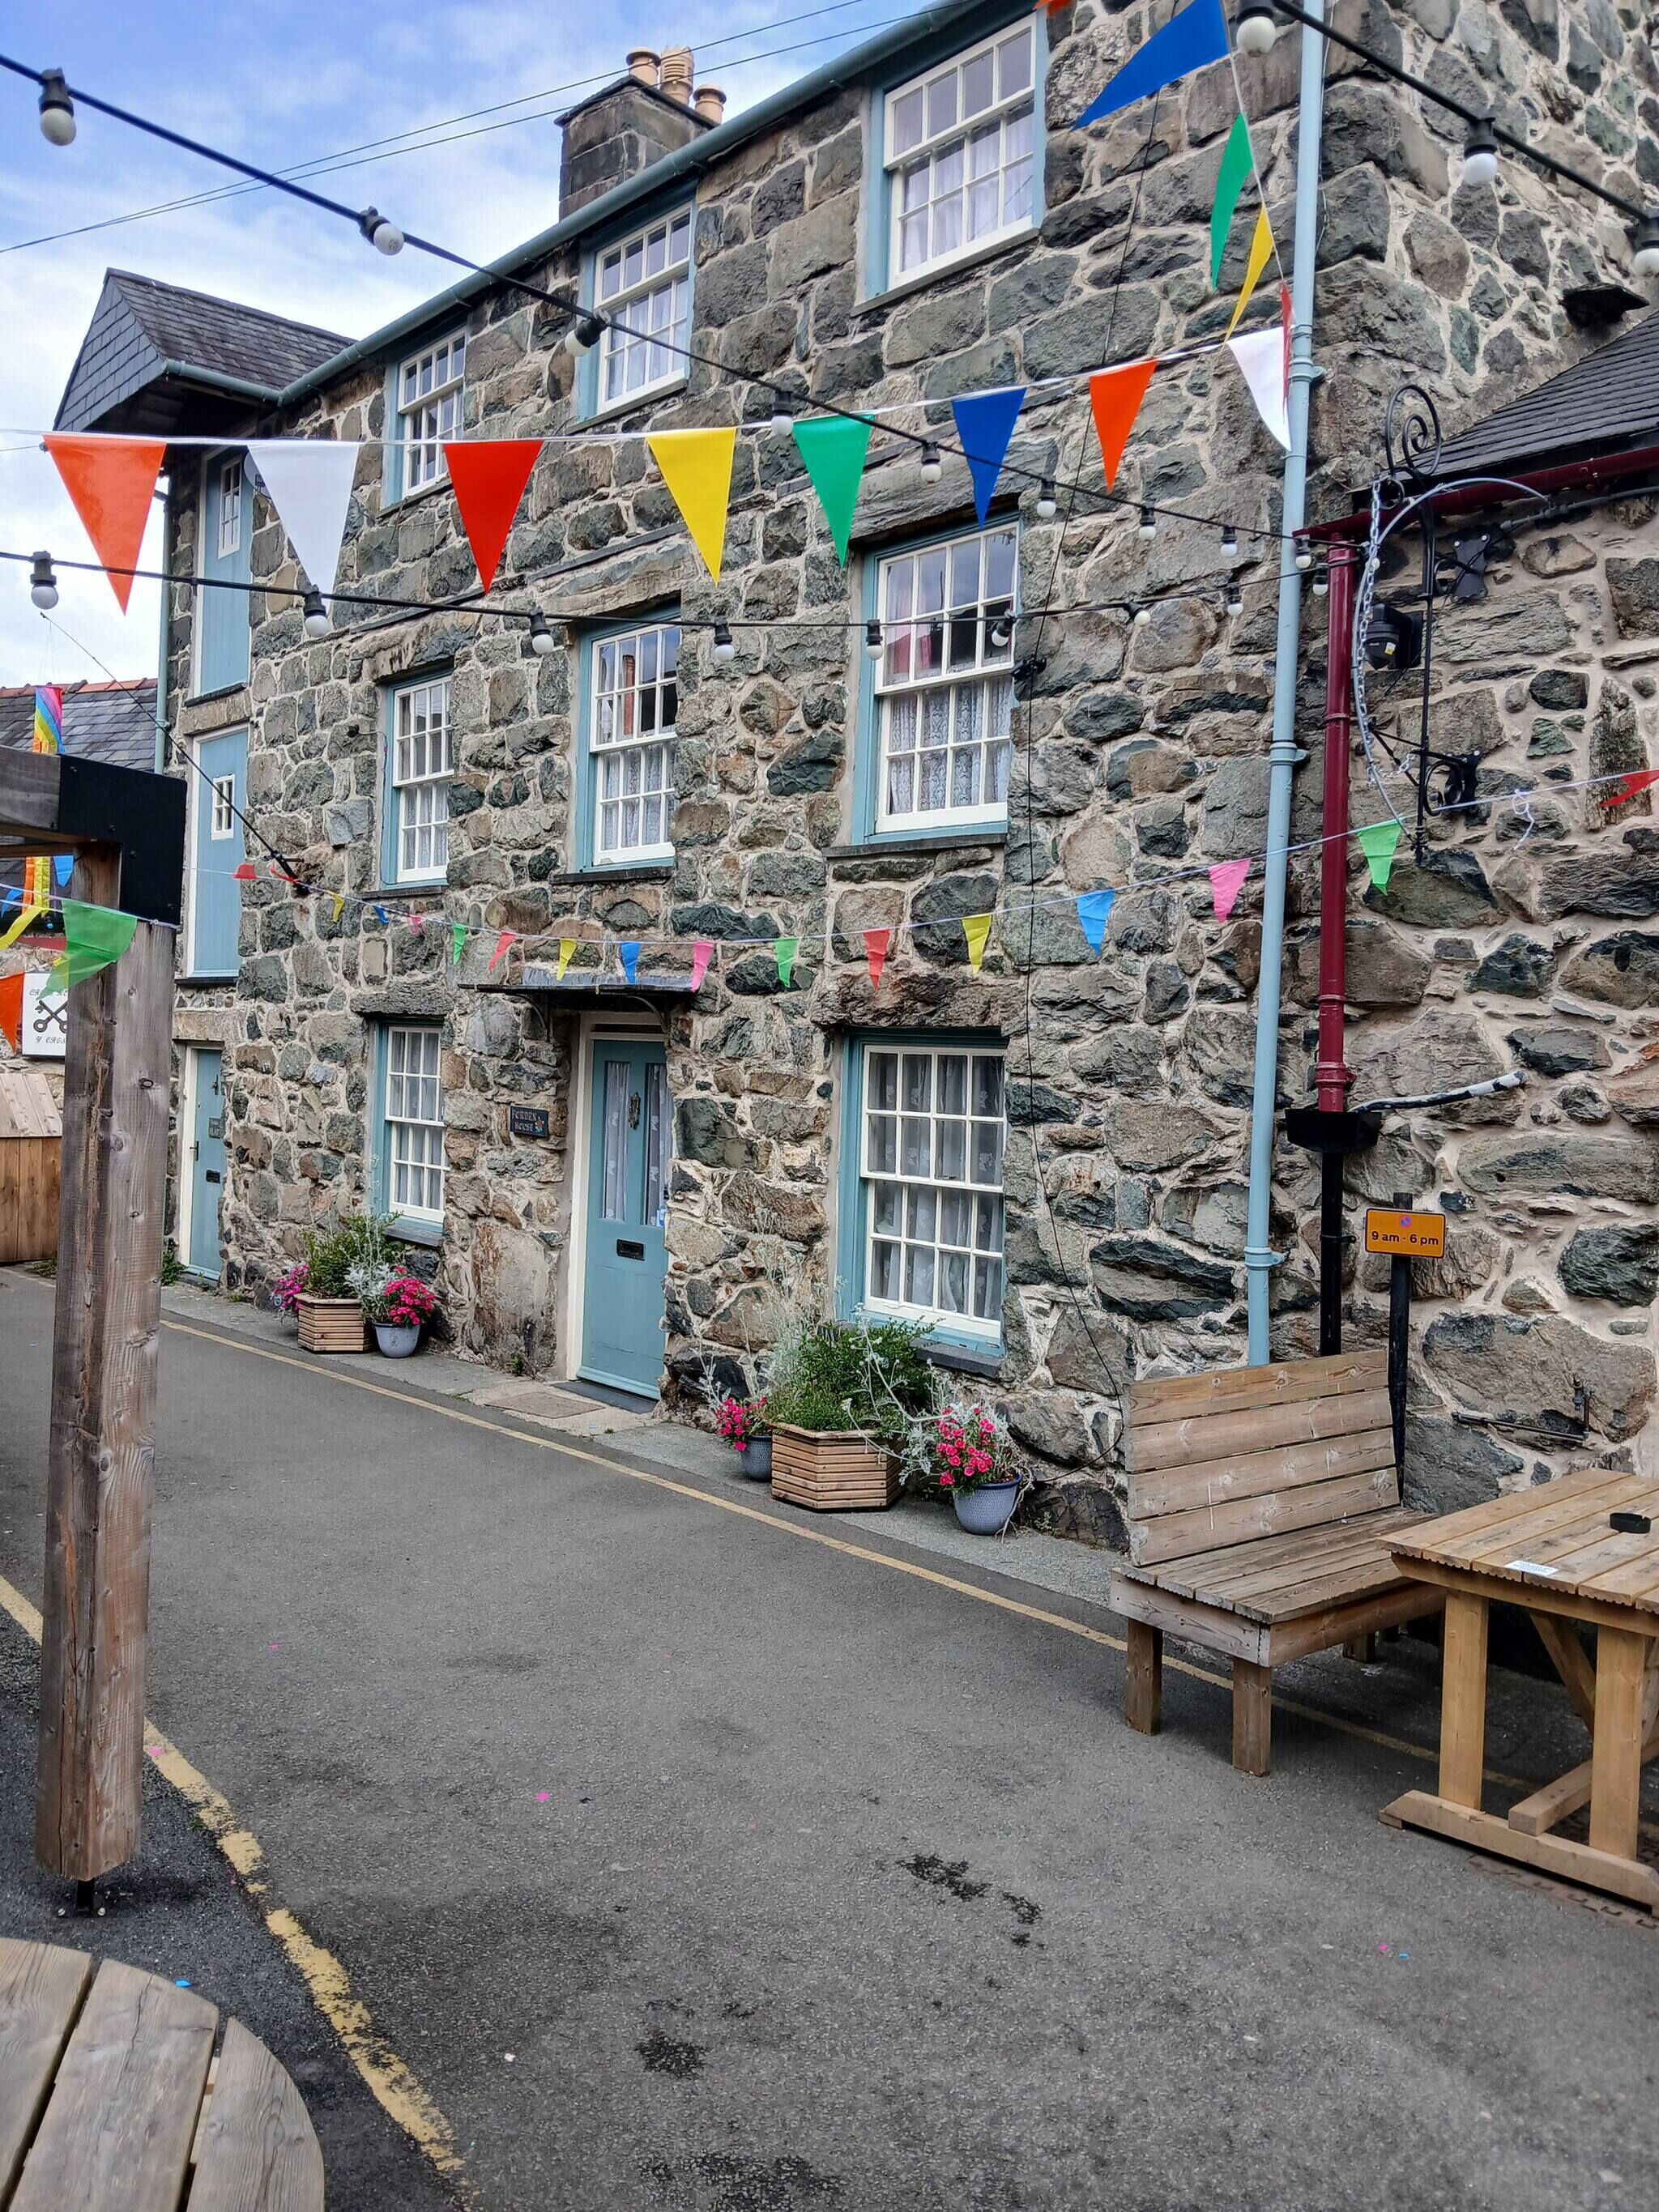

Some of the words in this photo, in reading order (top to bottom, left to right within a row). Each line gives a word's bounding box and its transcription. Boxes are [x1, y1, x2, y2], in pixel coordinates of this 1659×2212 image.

[514, 1121, 534, 1132] HOUSE
[1371, 1231, 1379, 1240] 9
[1382, 1234, 1400, 1242] am
[1410, 1234, 1418, 1243] 6
[1420, 1237, 1439, 1246] pm
